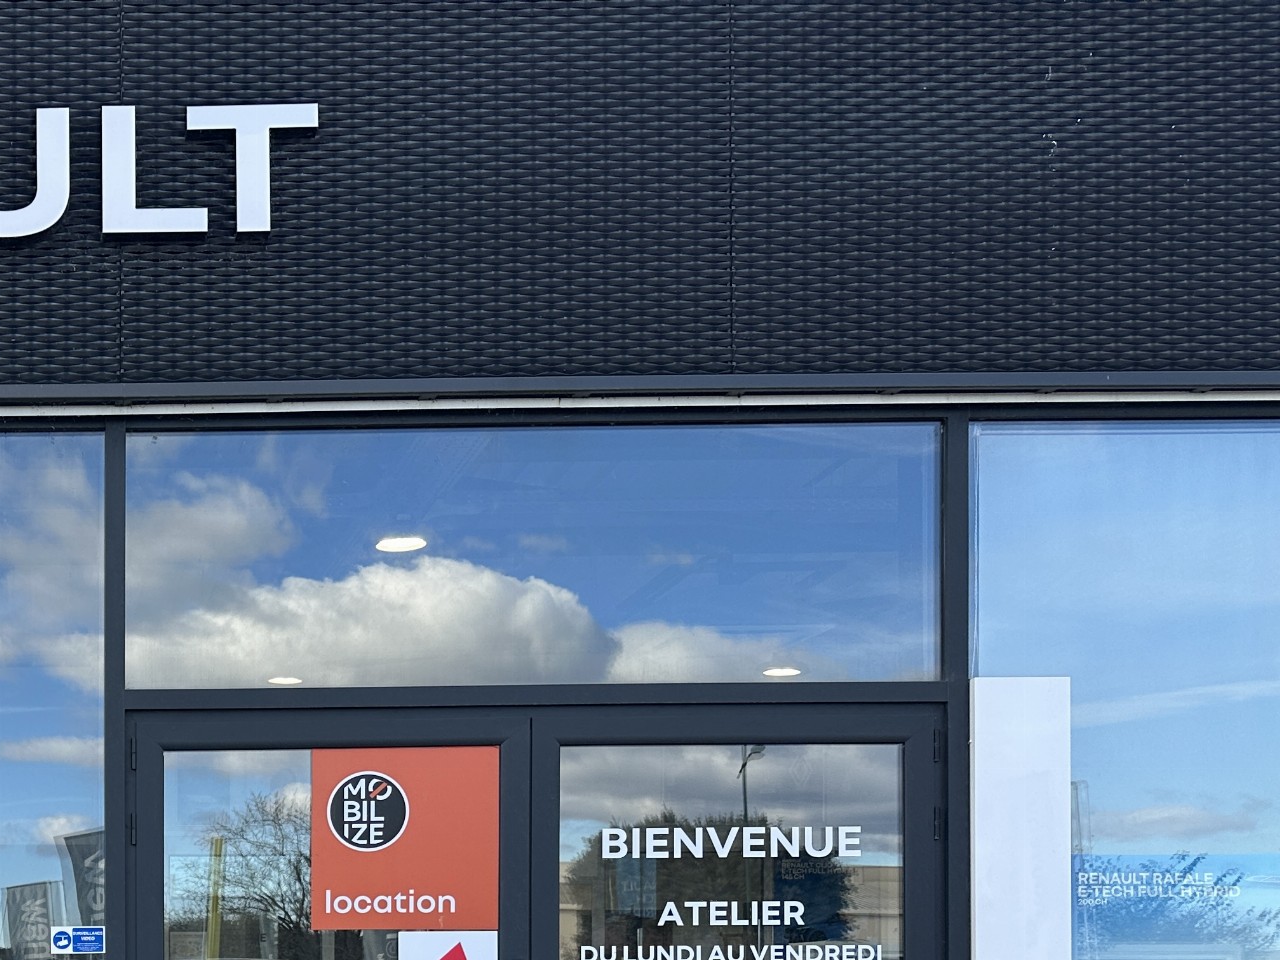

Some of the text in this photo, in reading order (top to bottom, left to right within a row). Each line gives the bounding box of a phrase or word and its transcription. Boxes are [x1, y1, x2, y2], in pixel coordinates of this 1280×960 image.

[601, 826, 862, 859] BIENVENUE
[1078, 872, 1214, 885] RENAULT RAFALE
[1078, 885, 1241, 897] E-TECH FULL HYBRID
[325, 889, 456, 914] location
[658, 901, 805, 926] ATELIER
